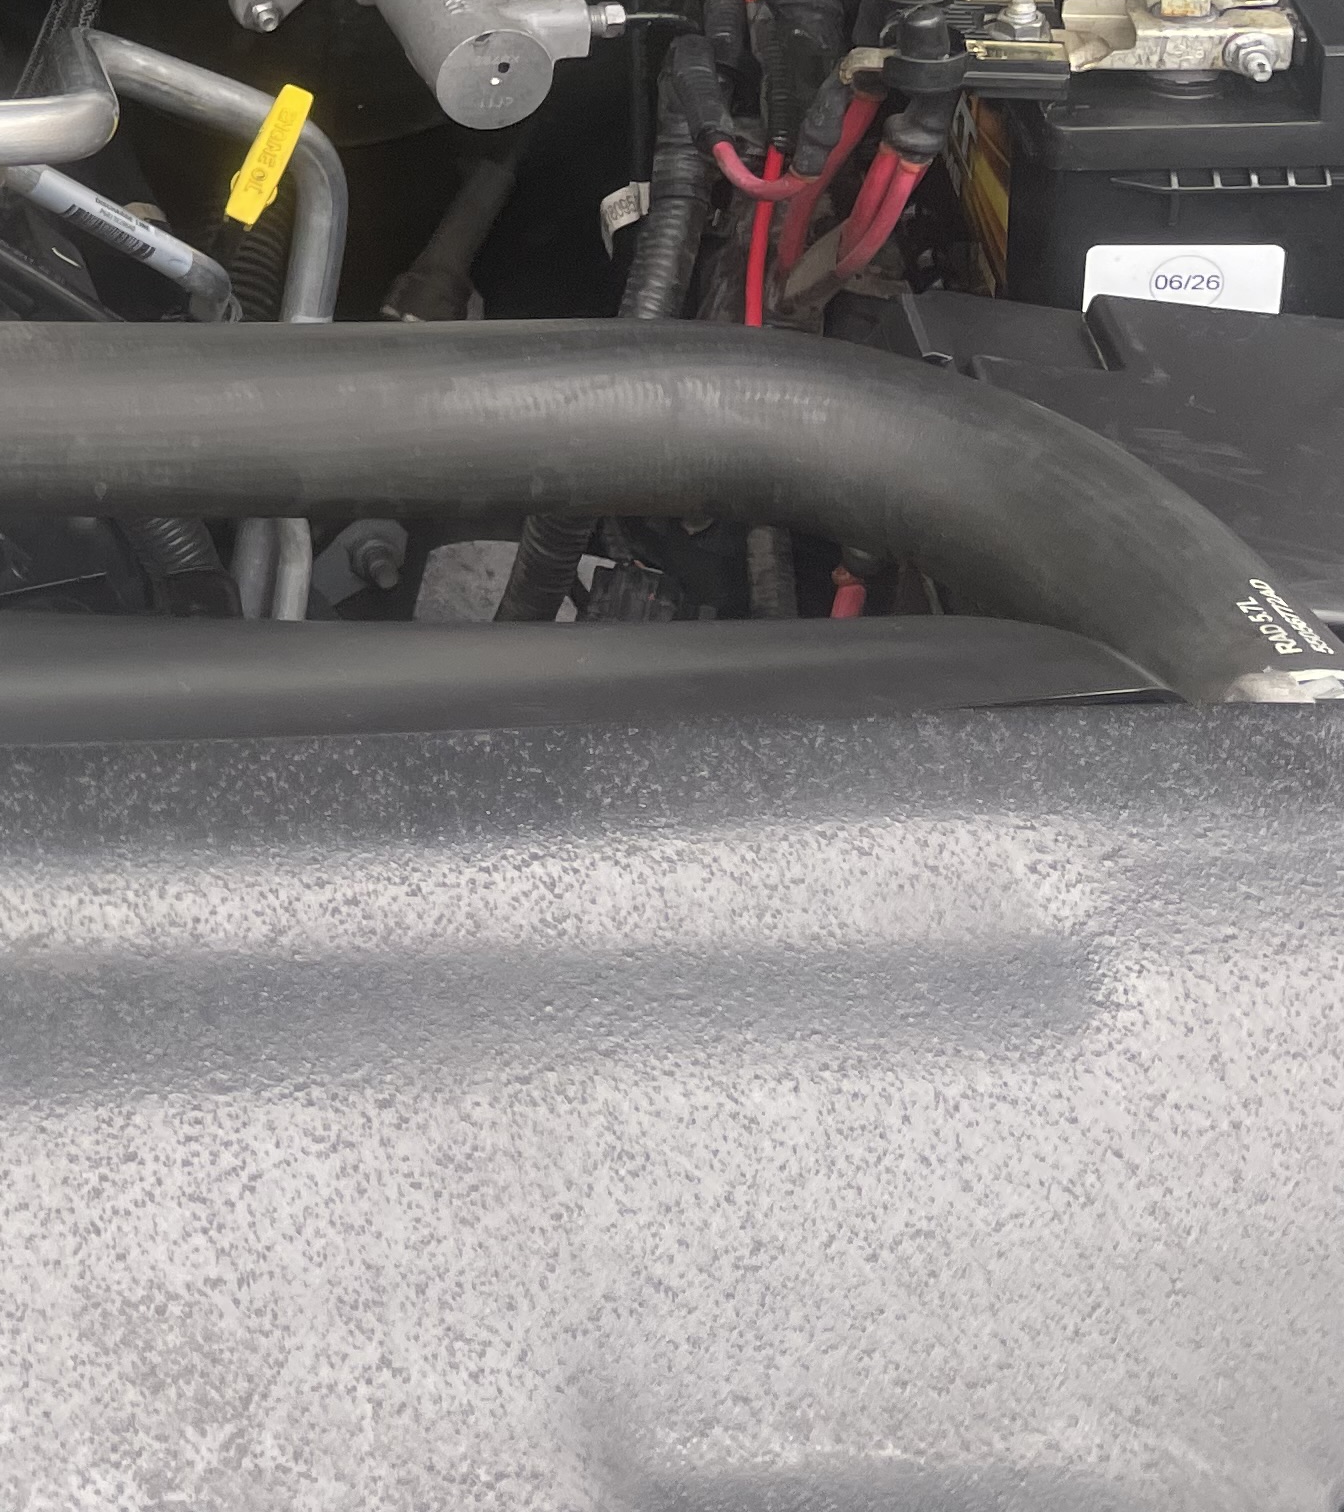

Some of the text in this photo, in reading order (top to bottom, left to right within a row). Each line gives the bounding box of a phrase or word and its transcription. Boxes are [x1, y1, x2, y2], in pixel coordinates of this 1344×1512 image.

[1154, 273, 1221, 293] 06/26
[1236, 596, 1303, 655] RAD 5.7L
